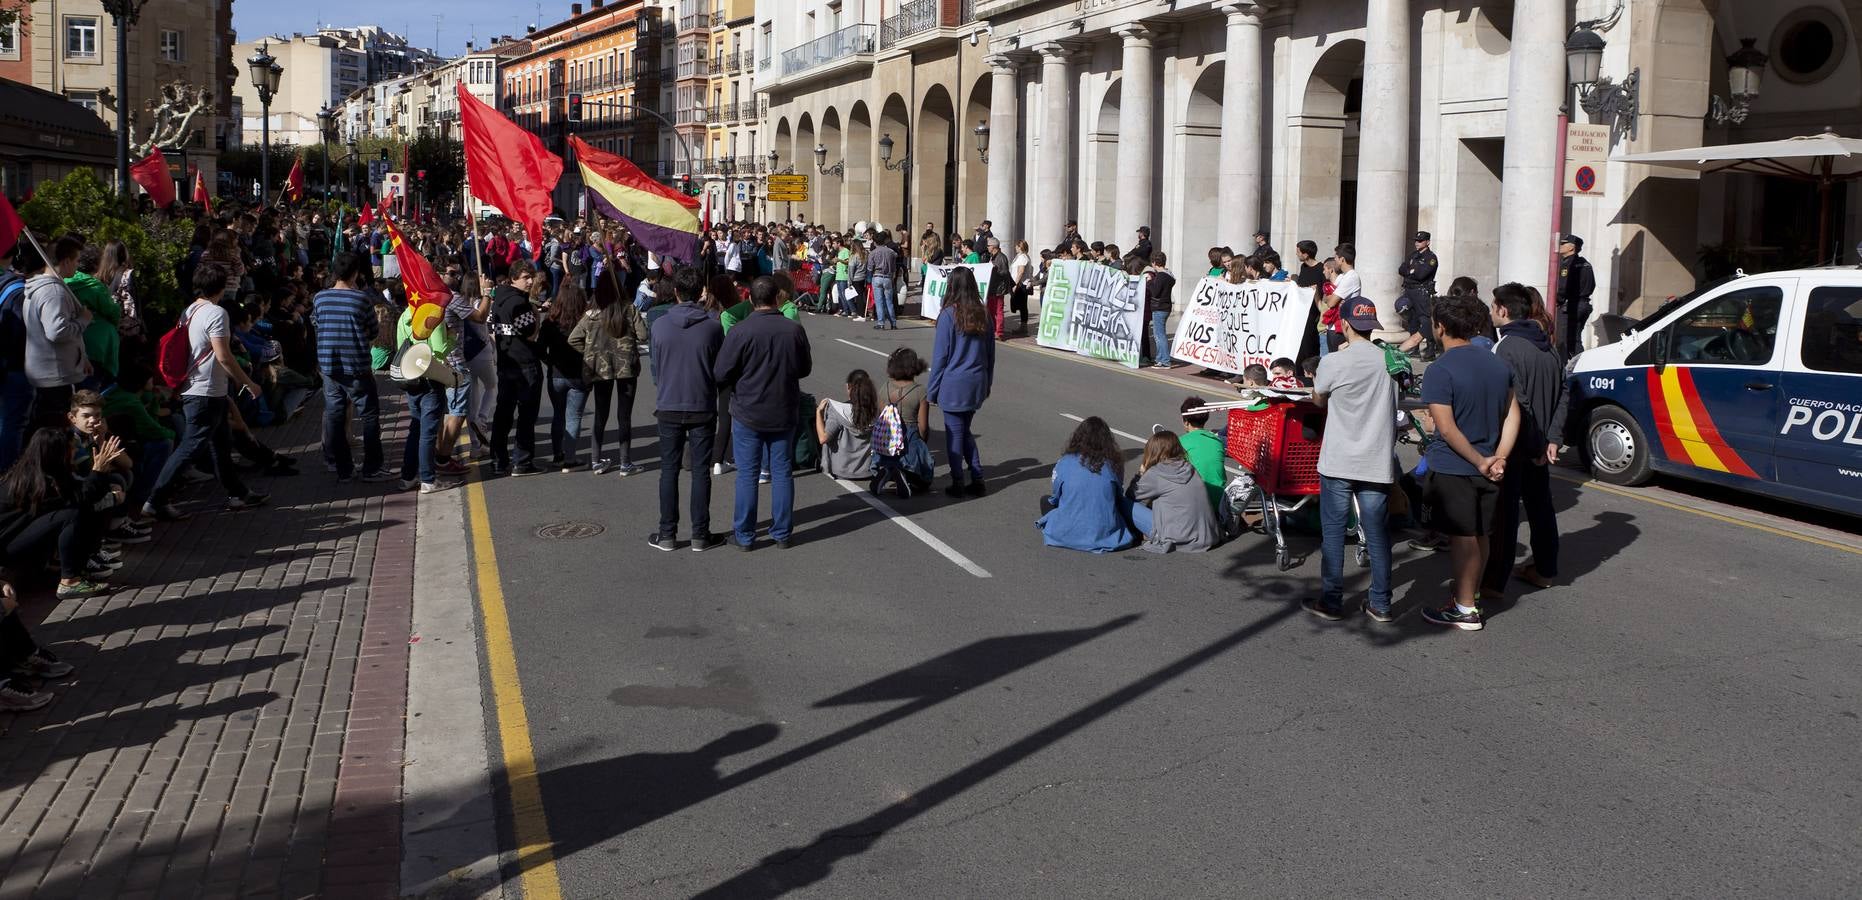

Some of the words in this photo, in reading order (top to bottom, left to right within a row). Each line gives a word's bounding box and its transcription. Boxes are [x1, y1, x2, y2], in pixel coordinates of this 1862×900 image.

[1571, 145, 1603, 153] GOBIERNO
[1076, 262, 1137, 312] LOMCE
[1043, 265, 1069, 338] STOP
[1071, 299, 1131, 336] RFORMA
[1185, 320, 1214, 344] NOS
[1595, 376, 1615, 390] 091
[1788, 397, 1834, 409] CUERPO
